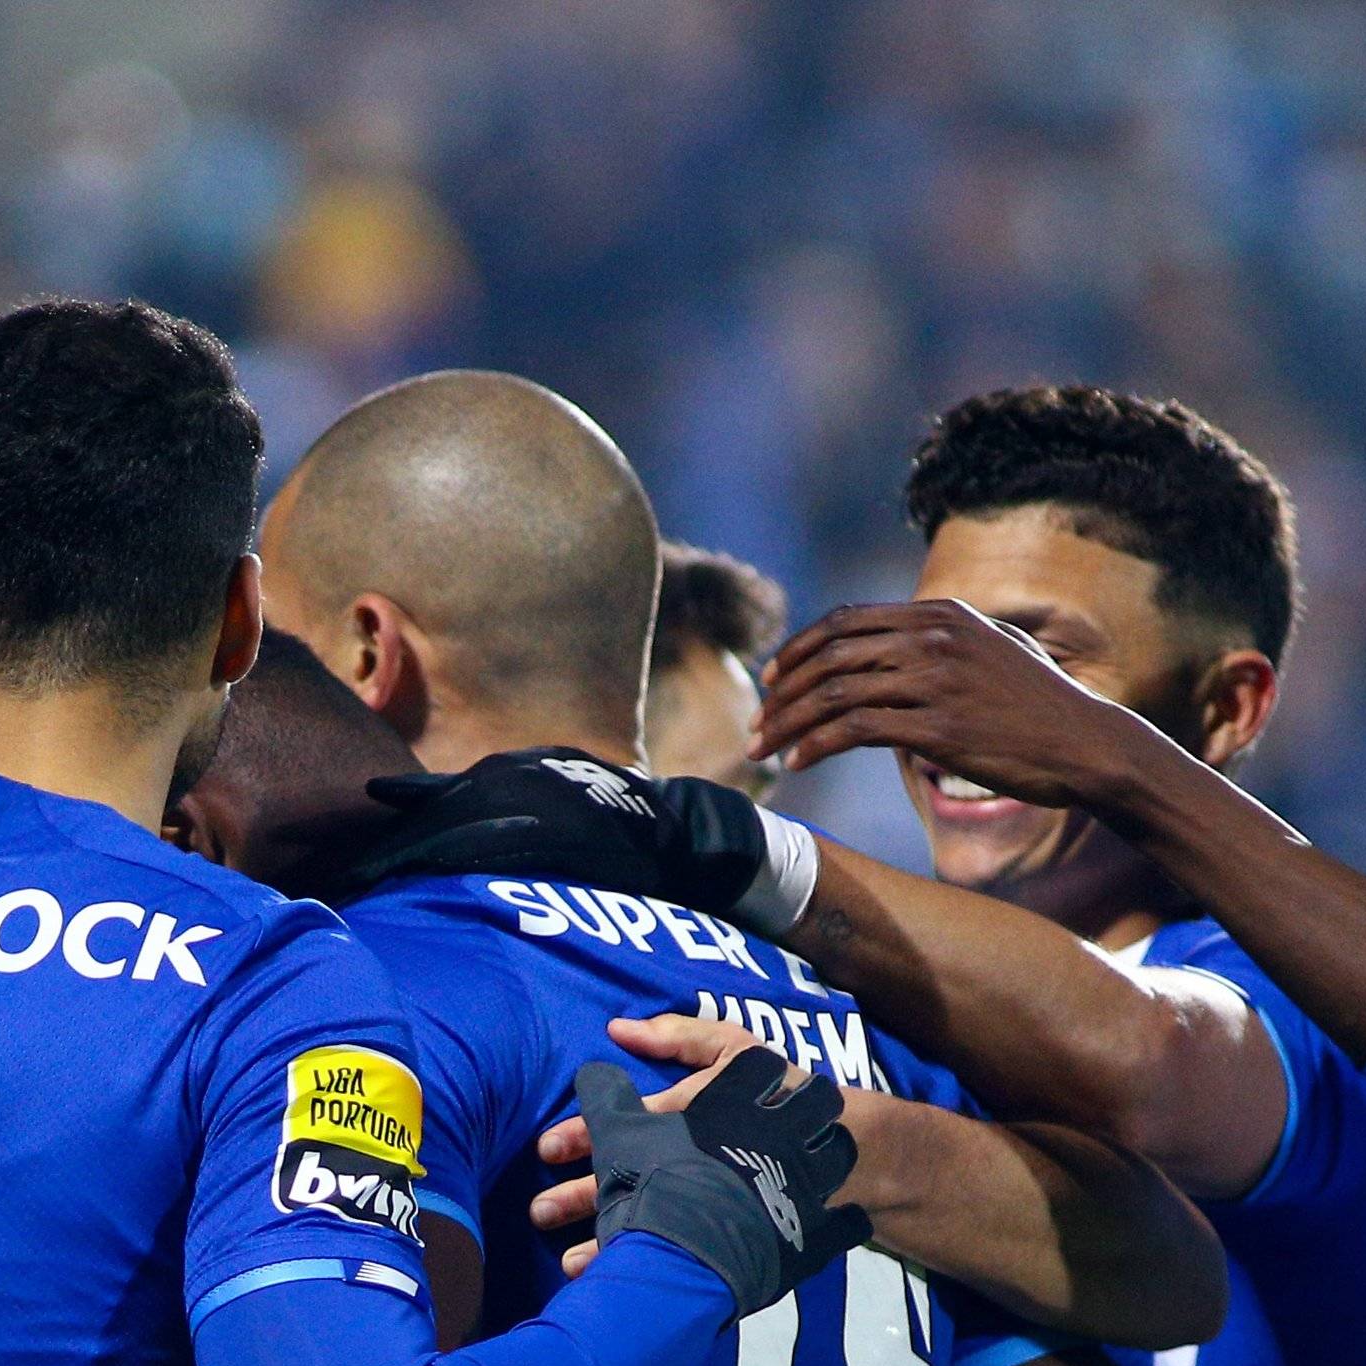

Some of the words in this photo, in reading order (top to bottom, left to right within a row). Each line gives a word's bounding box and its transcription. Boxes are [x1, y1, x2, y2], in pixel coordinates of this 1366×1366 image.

[488, 880, 770, 981] SUPER
[314, 1067, 366, 1098] LIGA
[288, 1151, 414, 1236] bwin
